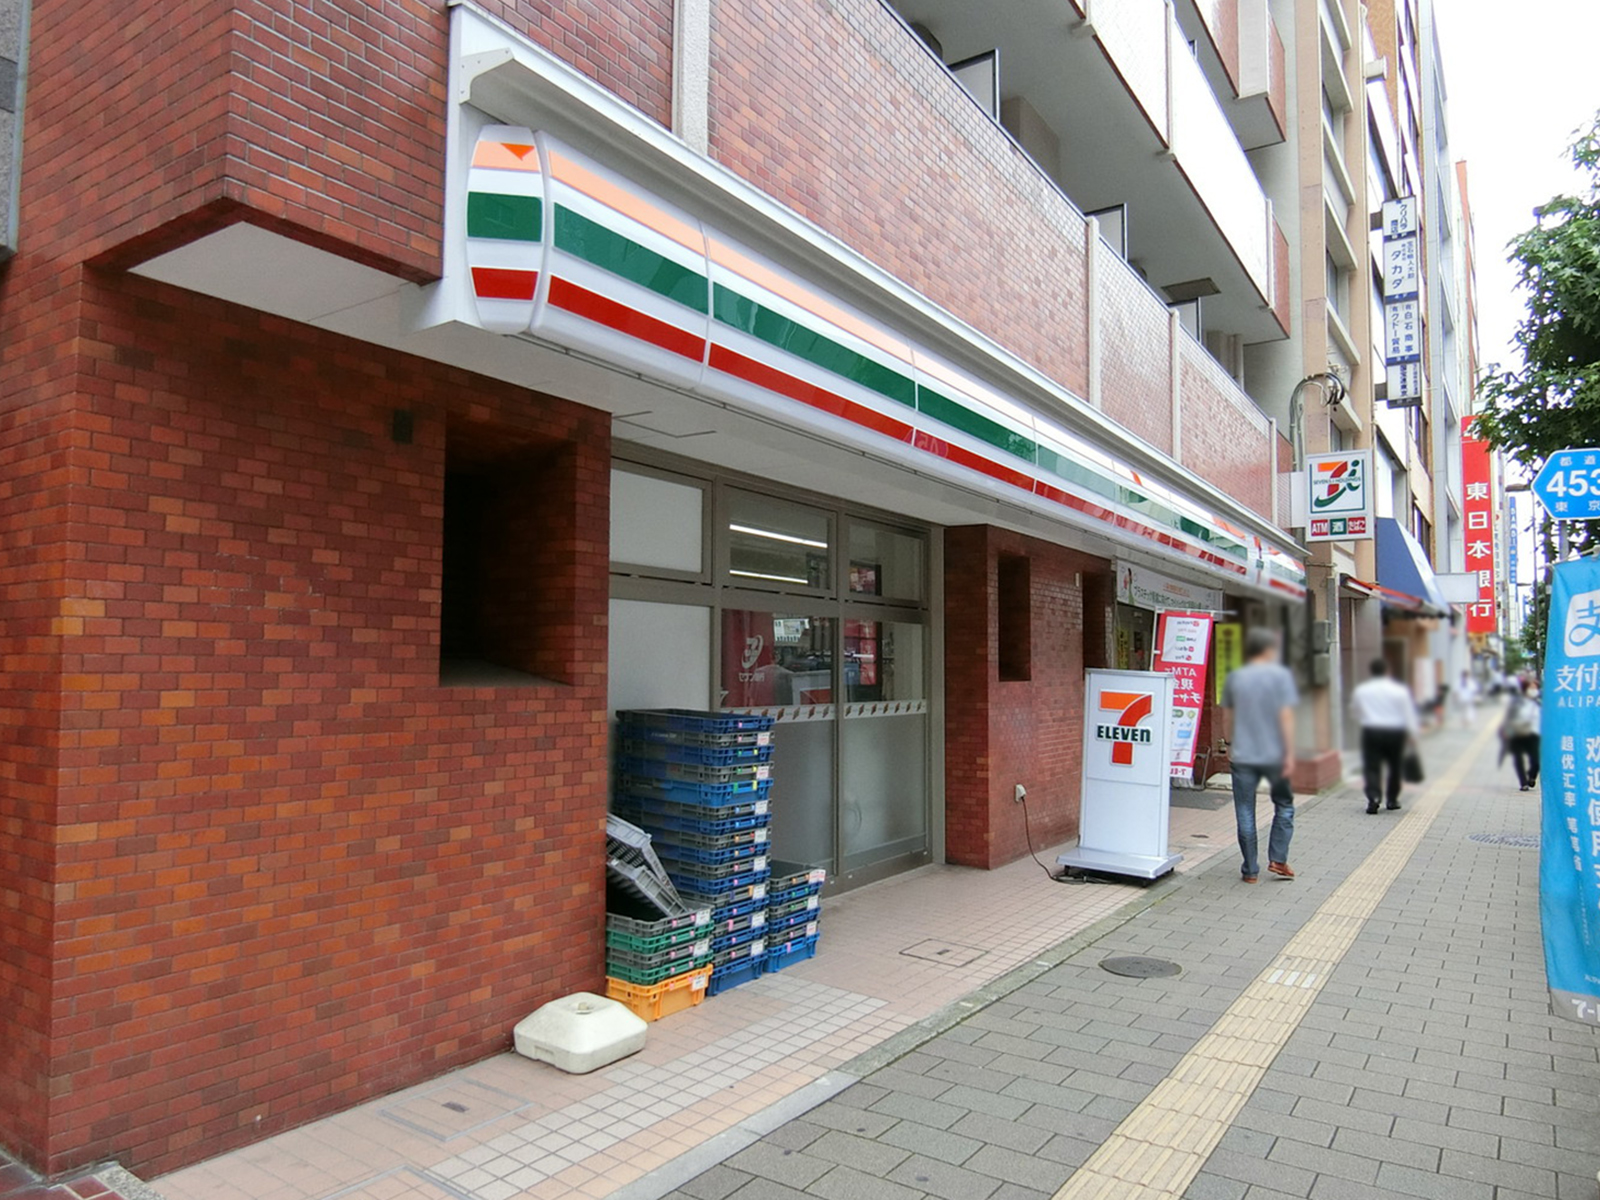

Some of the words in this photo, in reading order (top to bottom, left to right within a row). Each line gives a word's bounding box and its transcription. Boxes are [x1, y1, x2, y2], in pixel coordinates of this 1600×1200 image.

[1399, 204, 1408, 230] クリハラ
[1390, 250, 1405, 289] タカダ
[1555, 500, 1600, 513] 東京
[1312, 522, 1328, 534] ATM
[1466, 482, 1492, 618] 東日本銀行
[1554, 663, 1600, 692] 支付
